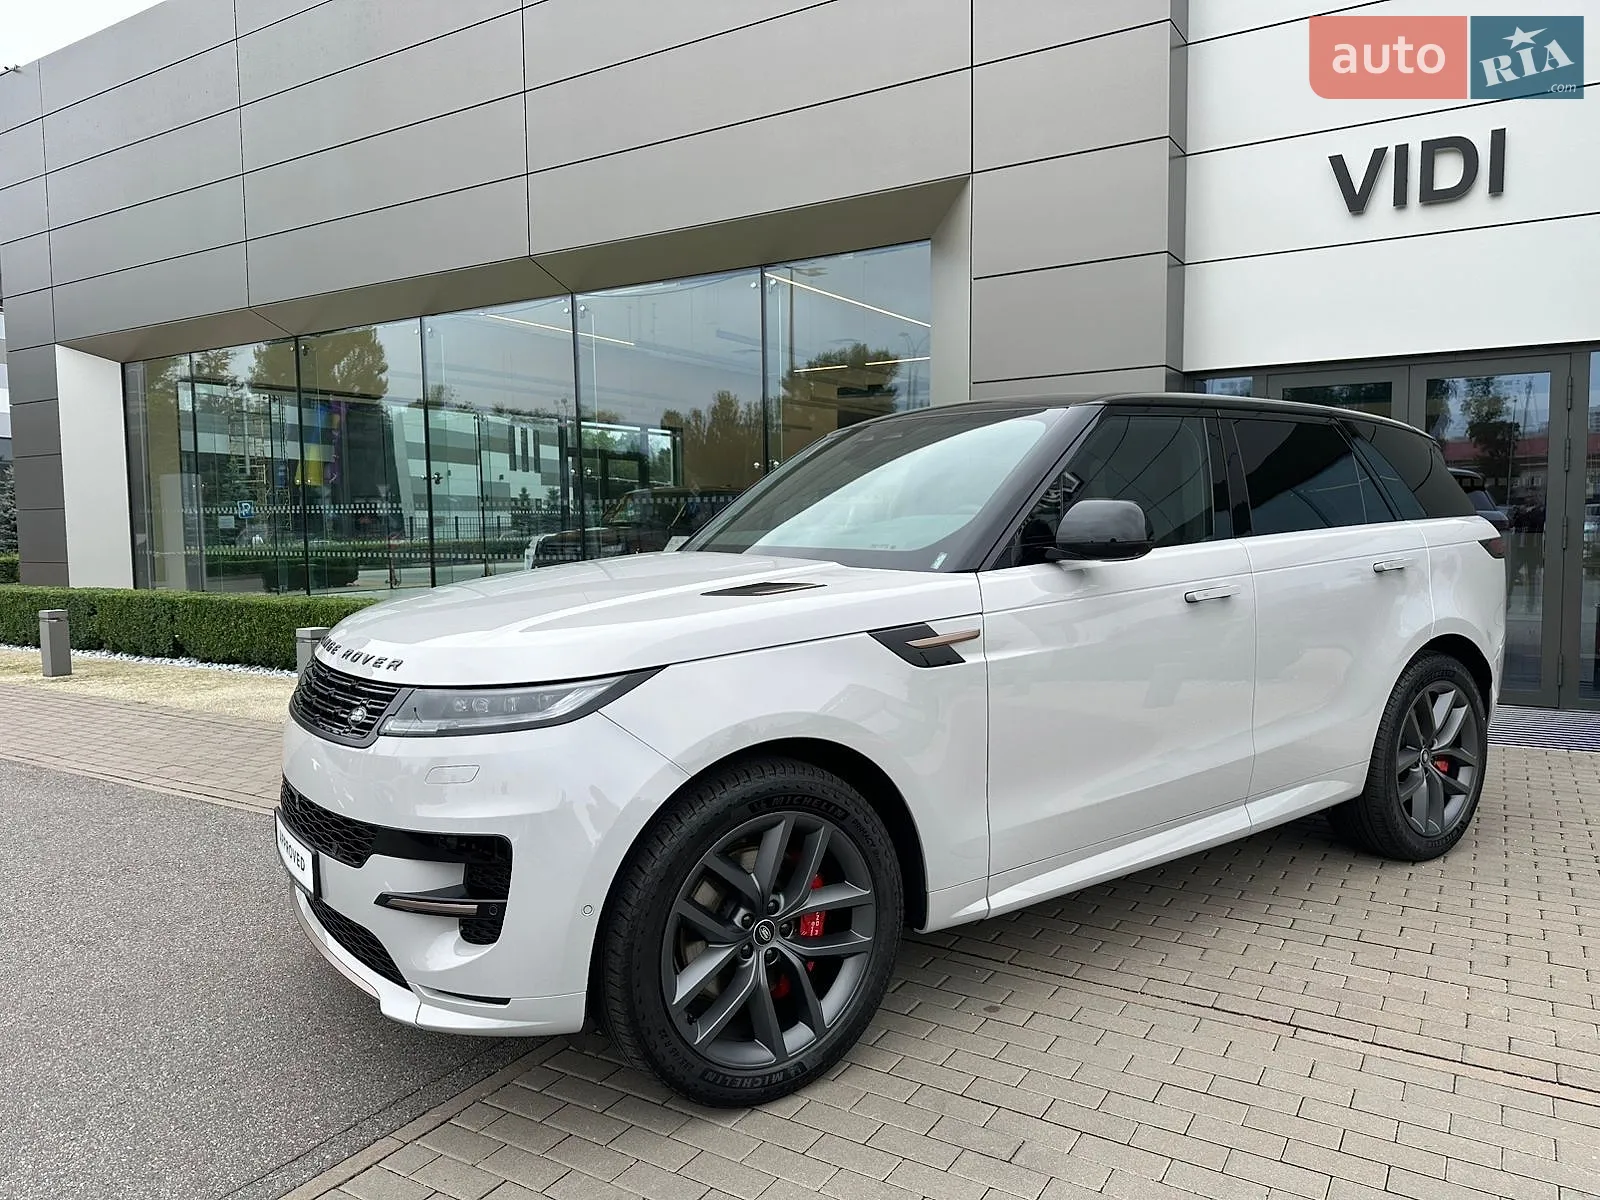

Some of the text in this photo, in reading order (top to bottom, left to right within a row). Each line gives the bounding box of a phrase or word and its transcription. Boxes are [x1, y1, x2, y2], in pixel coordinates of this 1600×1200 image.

[1328, 128, 1506, 215] VIDI
[341, 648, 404, 672] ROVER
[772, 794, 847, 819] MICHELIN
[704, 1071, 784, 1088] MICHELIN
